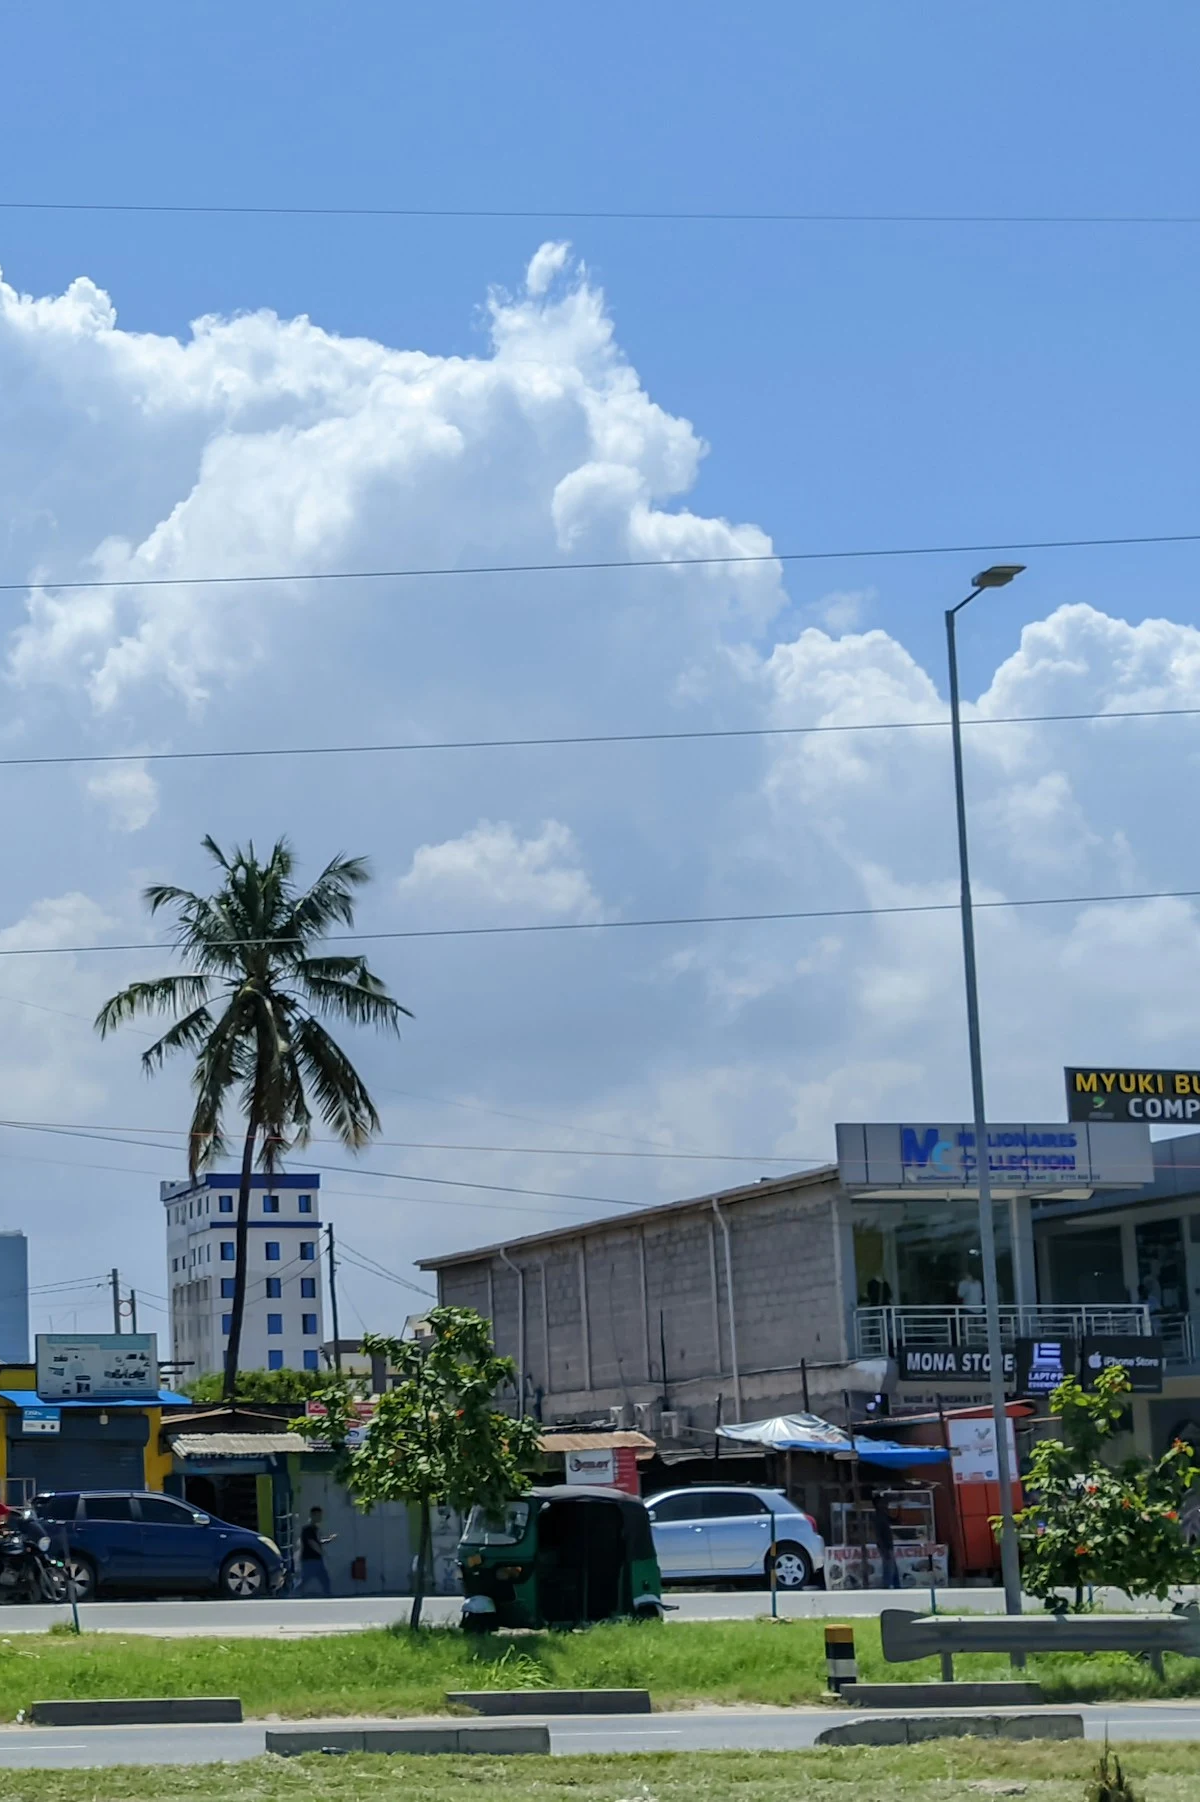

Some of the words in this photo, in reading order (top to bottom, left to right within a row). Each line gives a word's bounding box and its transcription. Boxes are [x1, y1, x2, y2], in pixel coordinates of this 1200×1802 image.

[1075, 1073, 1164, 1093] MYUKI
[1128, 1098, 1200, 1118] COMP
[958, 1132, 1077, 1147] MILIONAIRES
[960, 1155, 1076, 1171] CLLECTION
[907, 1353, 956, 1371] MONA
[962, 1353, 1014, 1371] STOE
[1136, 1356, 1159, 1366] Store
